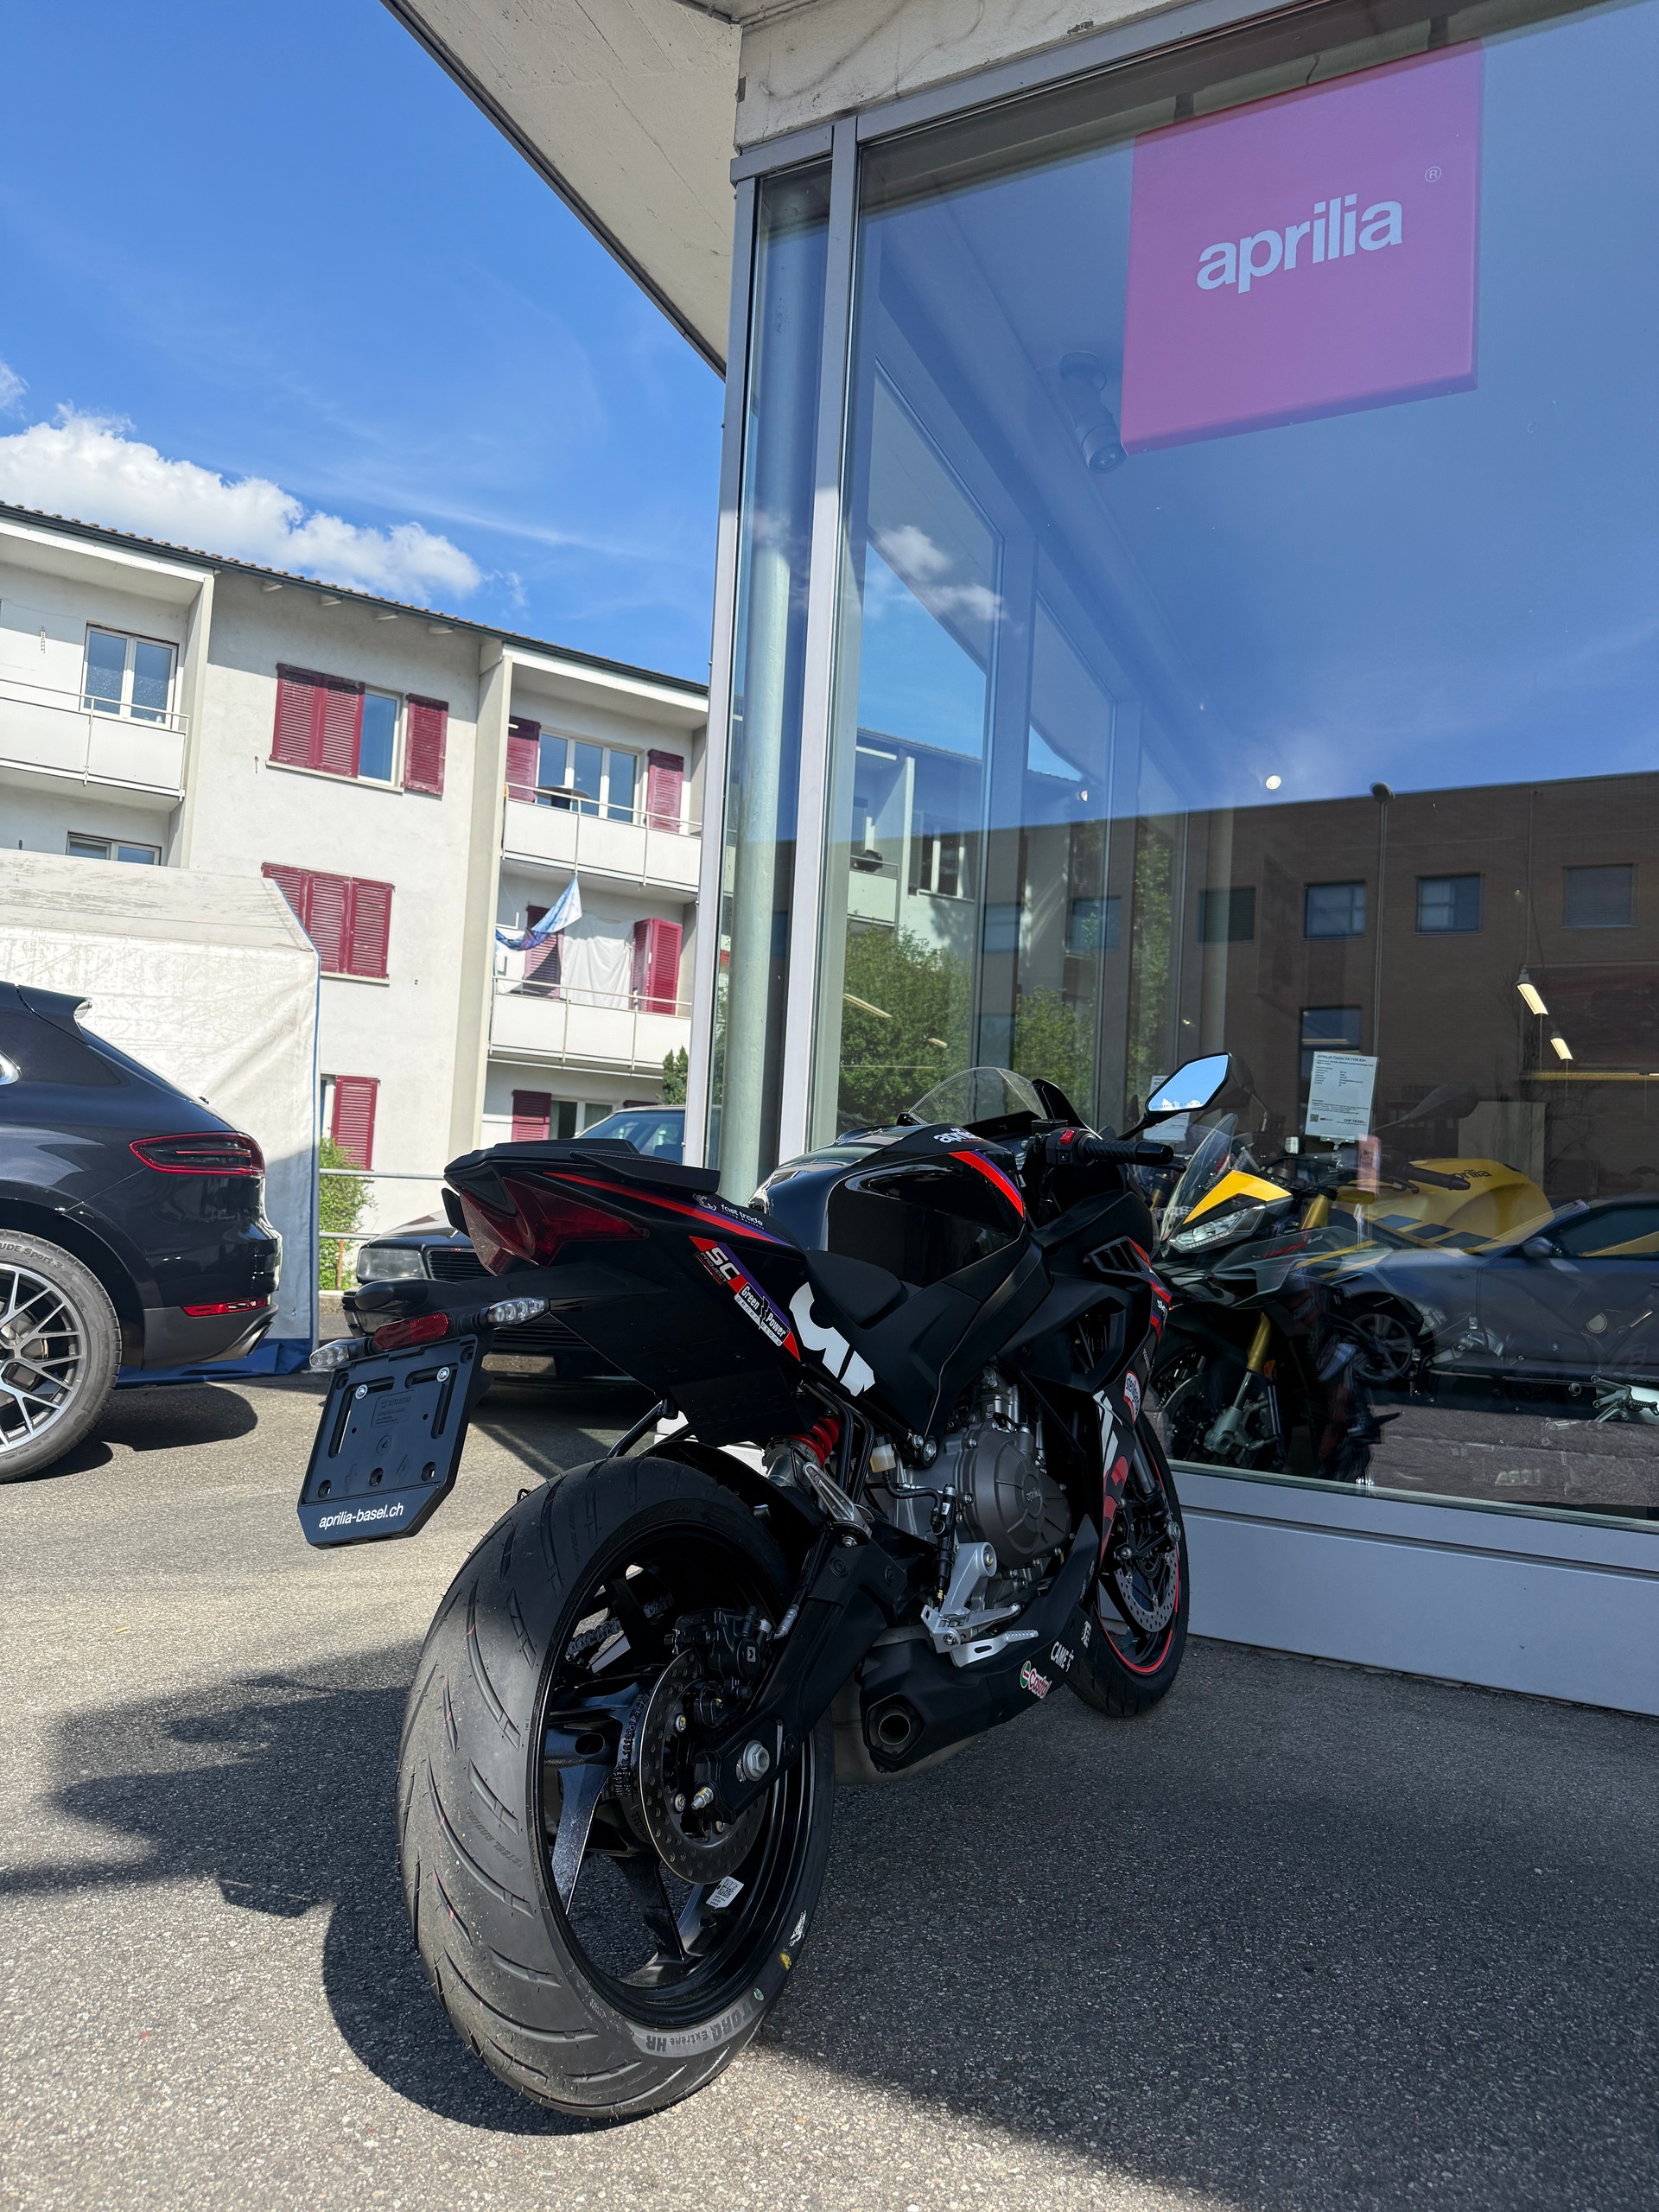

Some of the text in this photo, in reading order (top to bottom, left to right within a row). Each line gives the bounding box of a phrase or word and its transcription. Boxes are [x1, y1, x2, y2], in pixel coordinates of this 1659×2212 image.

[1197, 193, 1403, 294] aprilia
[1452, 1168, 1492, 1179] prilia
[22, 1247, 54, 1264] Sport
[700, 1251, 728, 1282] PROJECT
[705, 1247, 741, 1281] SC
[741, 1285, 786, 1338] Green Power
[318, 1502, 404, 1531] aprilia-basel.ch
[1028, 1668, 1052, 1700] Castrol
